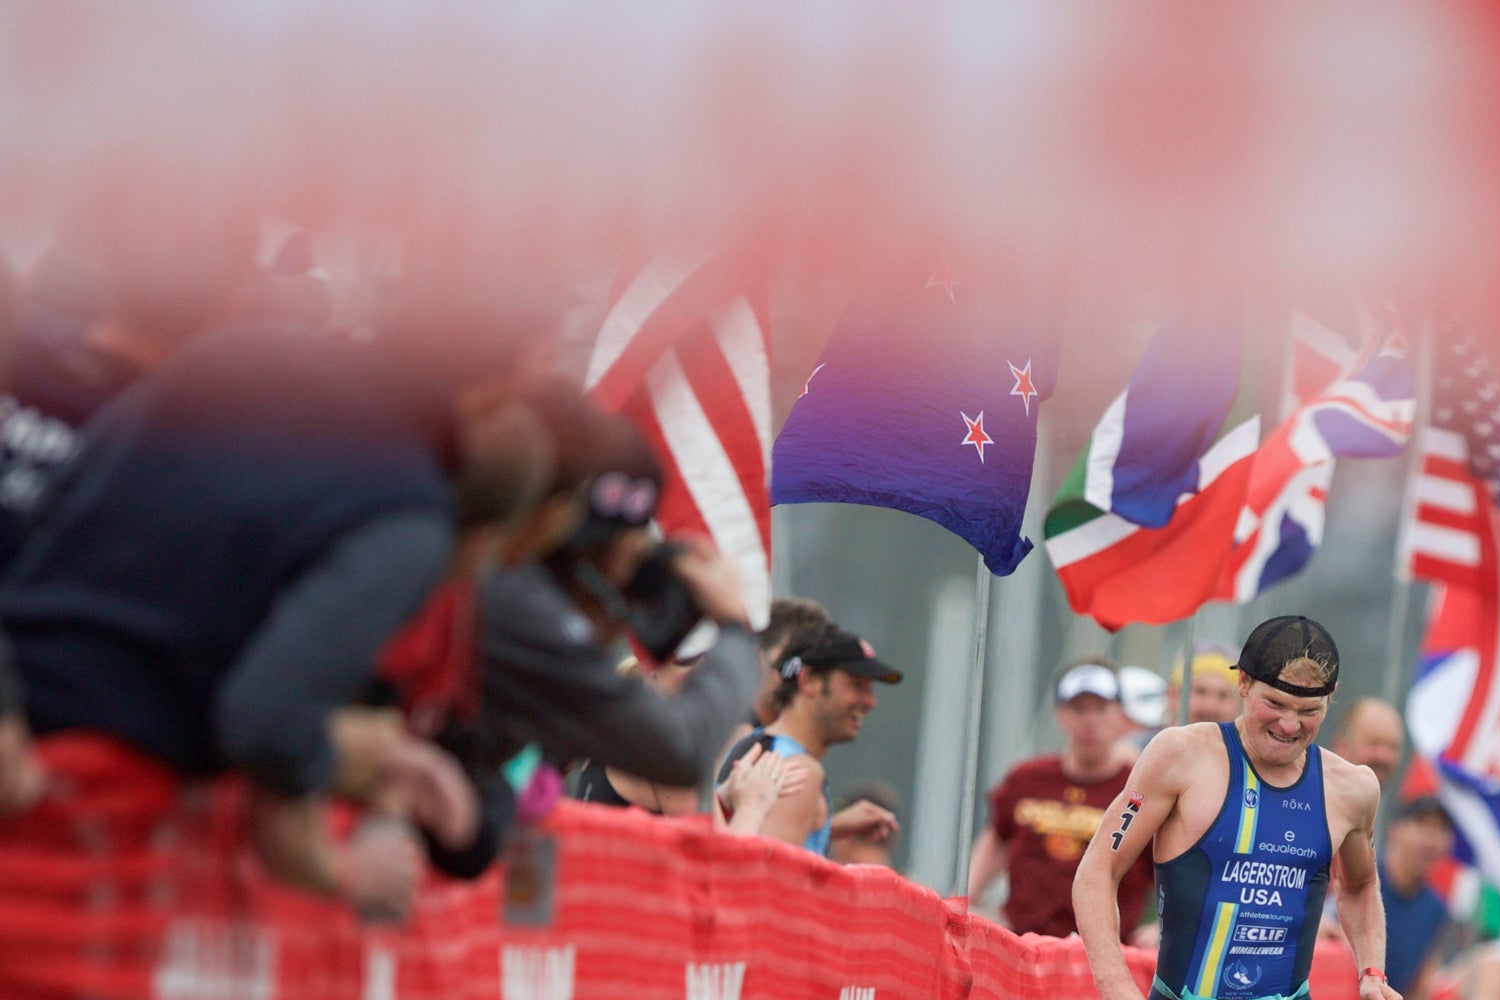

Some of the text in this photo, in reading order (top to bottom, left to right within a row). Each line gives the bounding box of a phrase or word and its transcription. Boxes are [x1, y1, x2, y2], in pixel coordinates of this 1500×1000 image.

[1259, 842, 1317, 860] equalearth
[1221, 860, 1307, 889] LAGERSTROM
[1240, 887, 1283, 907] USA
[1246, 928, 1285, 941] CLIF
[1229, 945, 1285, 955] NIMBLEWEAR
